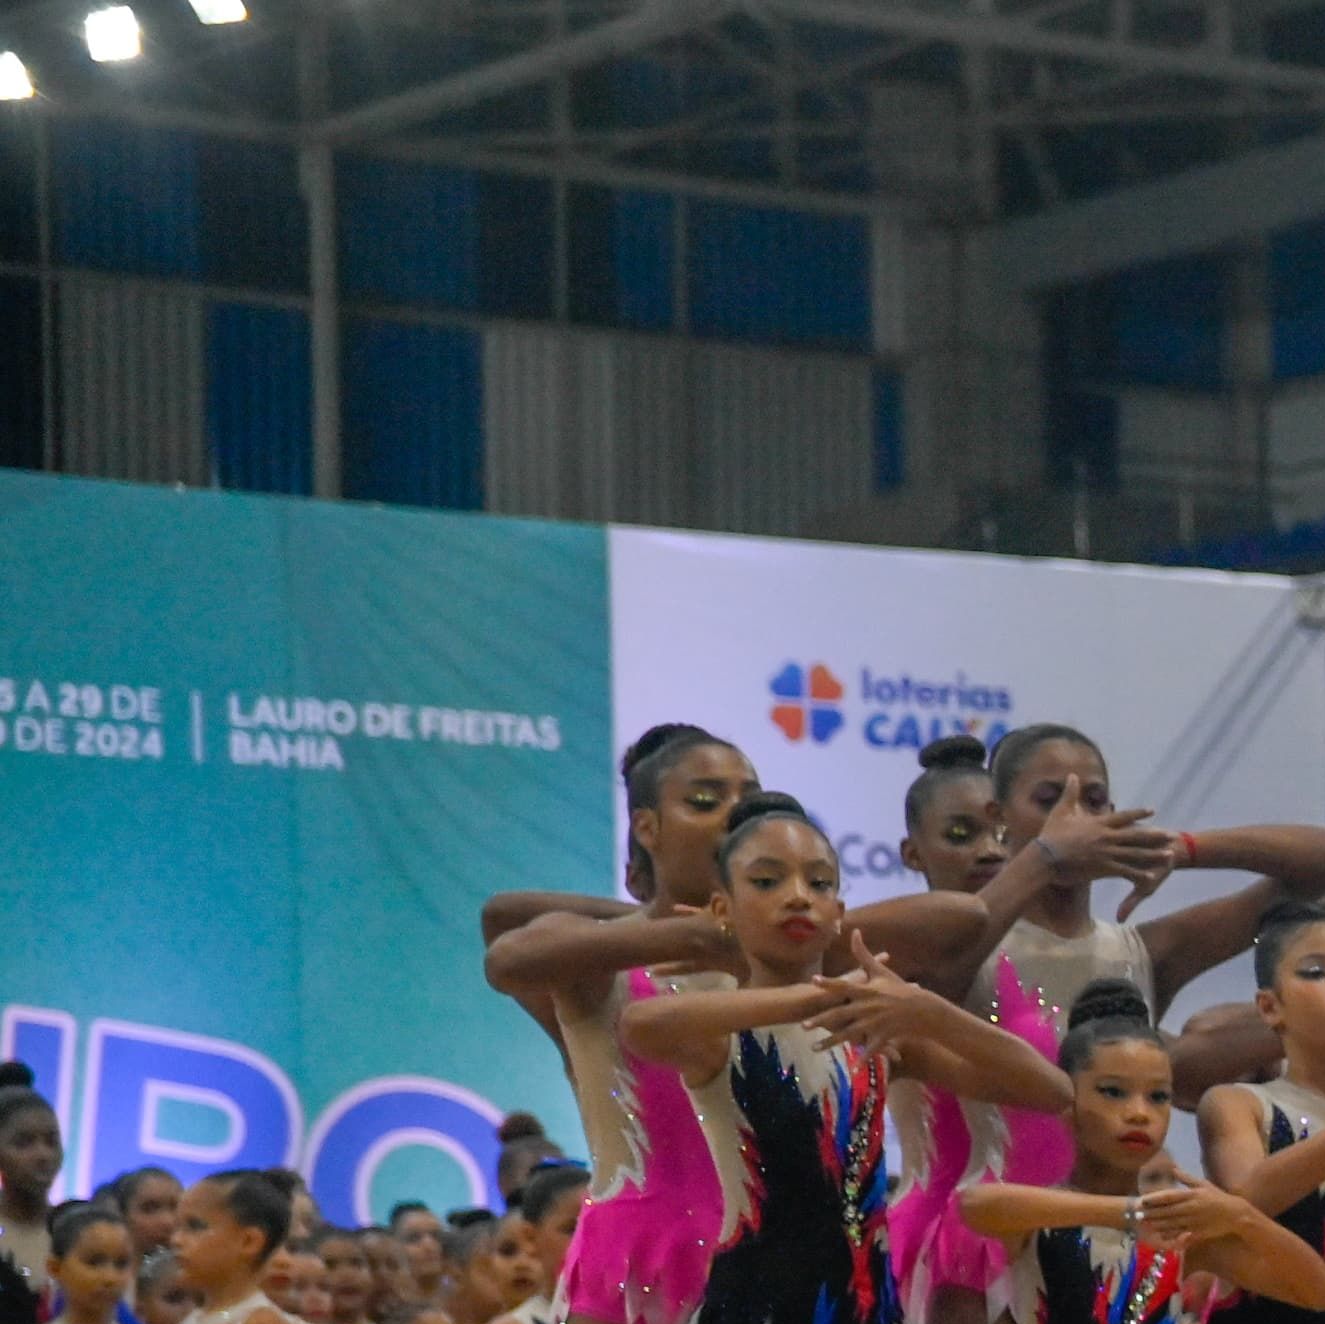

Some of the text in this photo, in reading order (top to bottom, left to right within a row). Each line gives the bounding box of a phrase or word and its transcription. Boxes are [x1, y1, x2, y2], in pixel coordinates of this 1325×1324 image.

[25, 679, 50, 713] A
[58, 682, 103, 718] 29
[110, 684, 163, 722] DE
[860, 666, 1011, 711] loterias
[15, 715, 66, 755] DE
[74, 720, 163, 760] 2024
[229, 693, 561, 750] LAURO DE FREITAS
[229, 729, 344, 770] BAHIA
